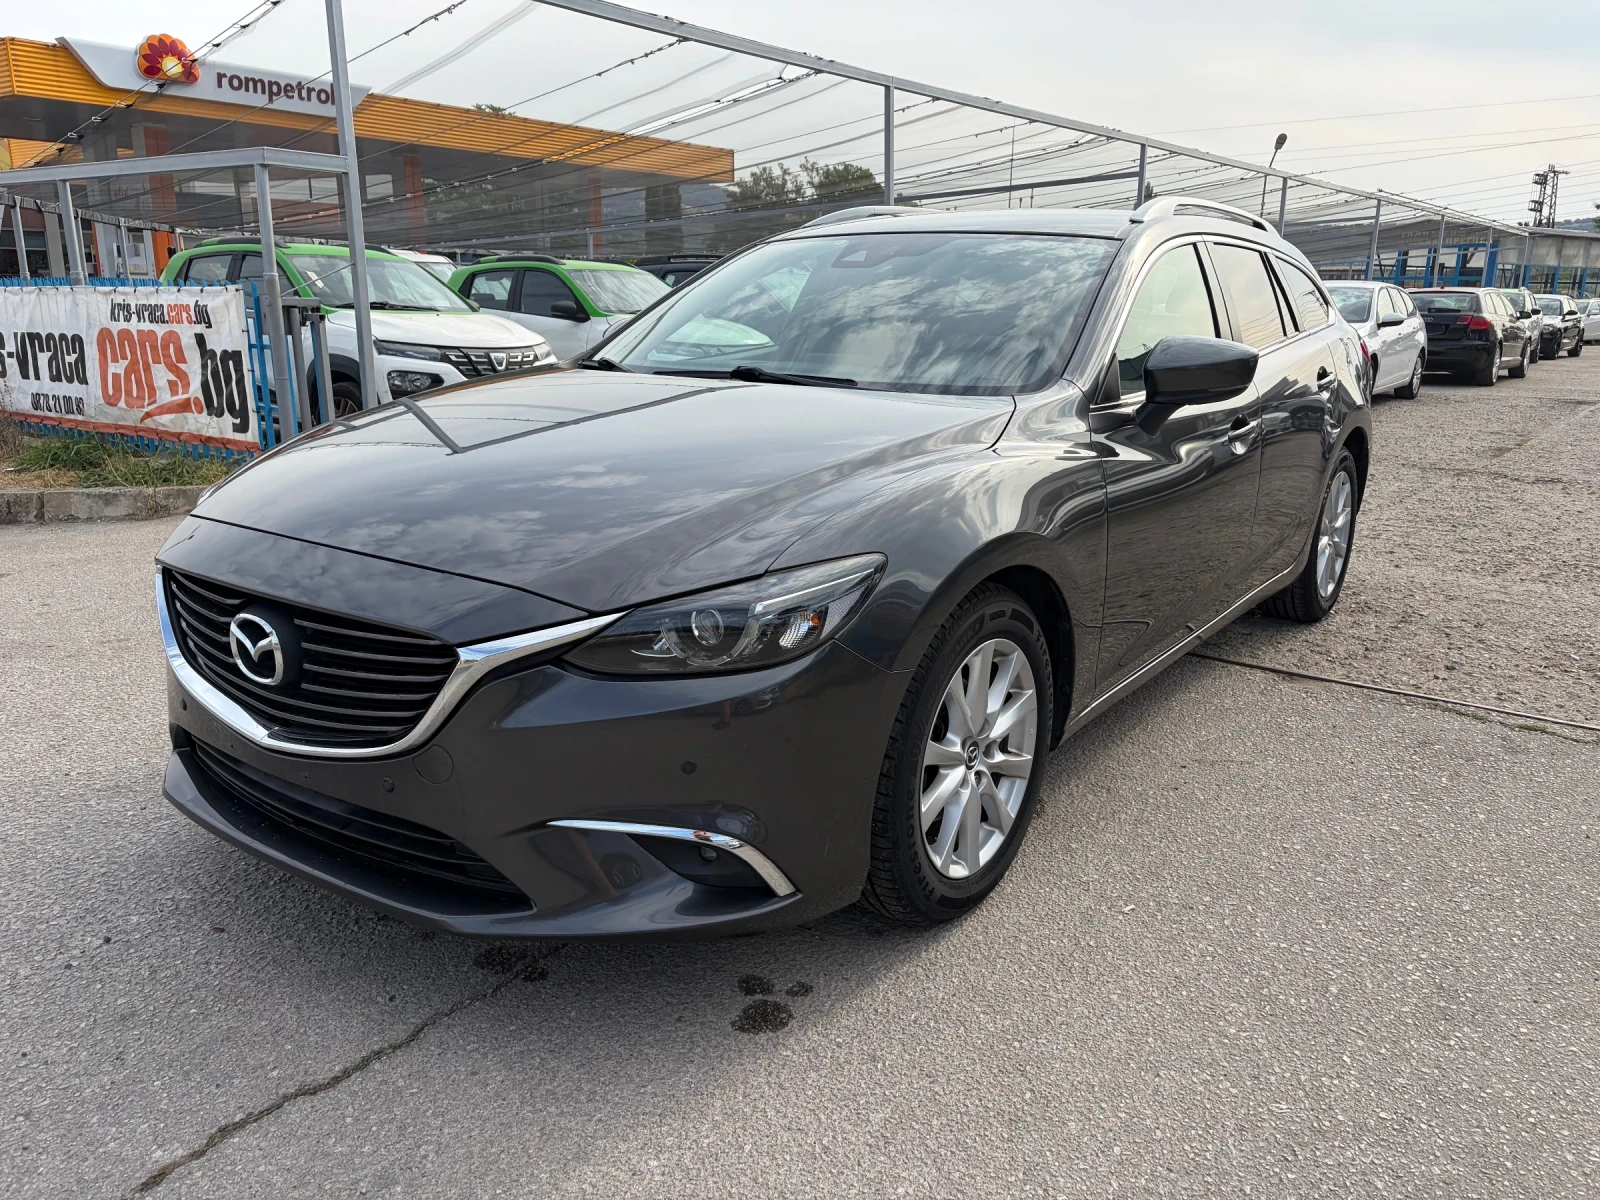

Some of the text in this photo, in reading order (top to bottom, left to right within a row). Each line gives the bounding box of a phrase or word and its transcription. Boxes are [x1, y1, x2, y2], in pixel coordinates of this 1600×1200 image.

[216, 72, 335, 105] rompetrol
[110, 298, 212, 329] kris-vraca.cars.bg
[51, 393, 63, 414] 21
[62, 394, 75, 415] 00
